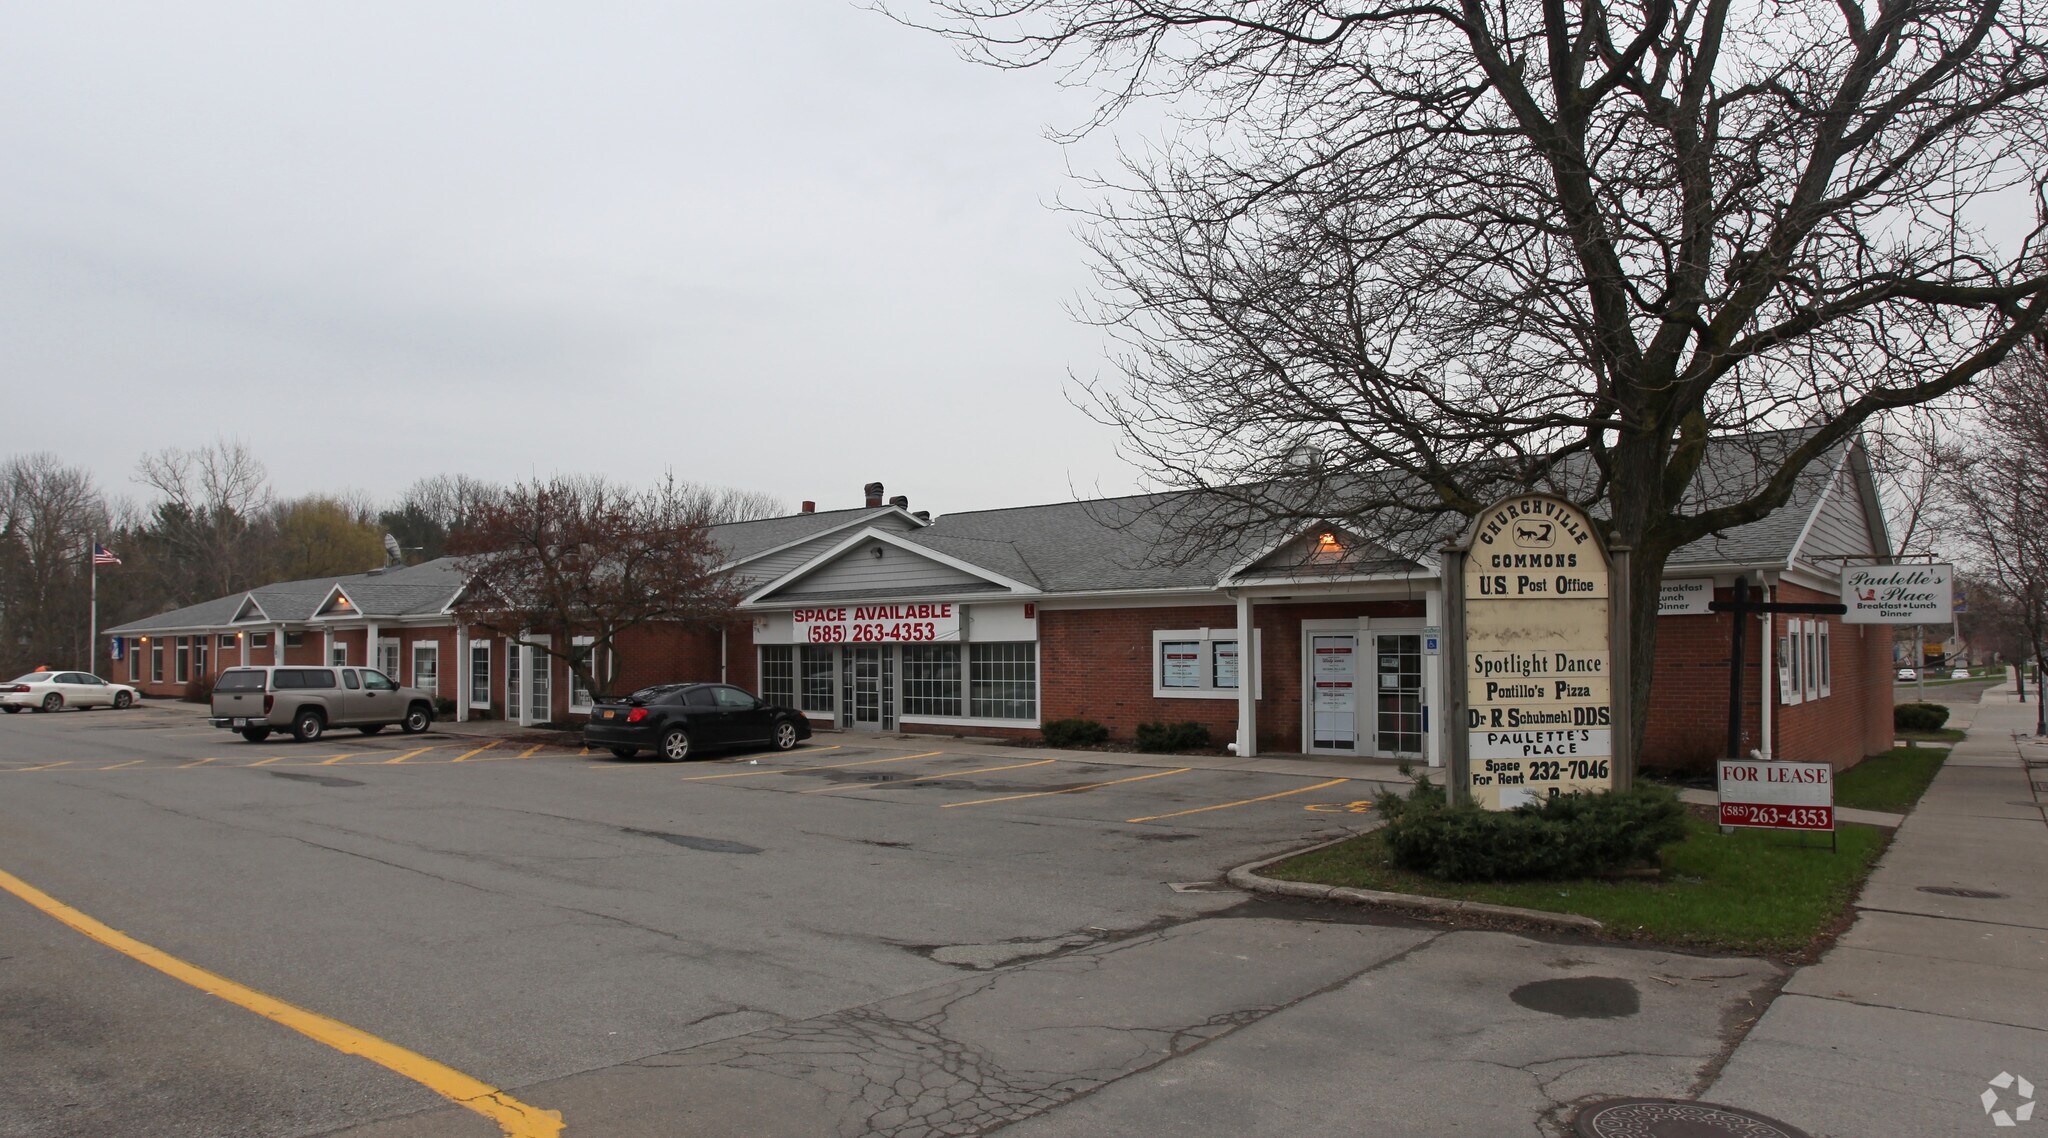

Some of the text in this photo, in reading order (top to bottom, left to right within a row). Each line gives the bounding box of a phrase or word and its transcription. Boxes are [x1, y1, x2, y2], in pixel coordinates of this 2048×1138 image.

[1480, 500, 1589, 545] CHURCHVILLE
[1491, 554, 1577, 568] COMMONS
[1479, 575, 1594, 595] U.S. Post Office
[1848, 568, 1946, 586] Paulette's
[1880, 587, 1938, 601] Place
[794, 604, 952, 623] SPACE AVAILABLE
[807, 622, 936, 643] (585) 263-4353
[1474, 653, 1601, 677] Spotlight Dance
[1486, 680, 1591, 701] Pontillo's Pizza
[1468, 708, 1487, 729] Dr
[1508, 708, 1572, 727] Schubmehl
[1487, 730, 1590, 745] PAULETTE'S
[1523, 743, 1577, 756] PLACE
[1485, 759, 1520, 774] Space
[1529, 759, 1609, 781] 232-7046
[1722, 766, 1828, 784] FOR LEASE
[1473, 772, 1525, 785] For Rent
